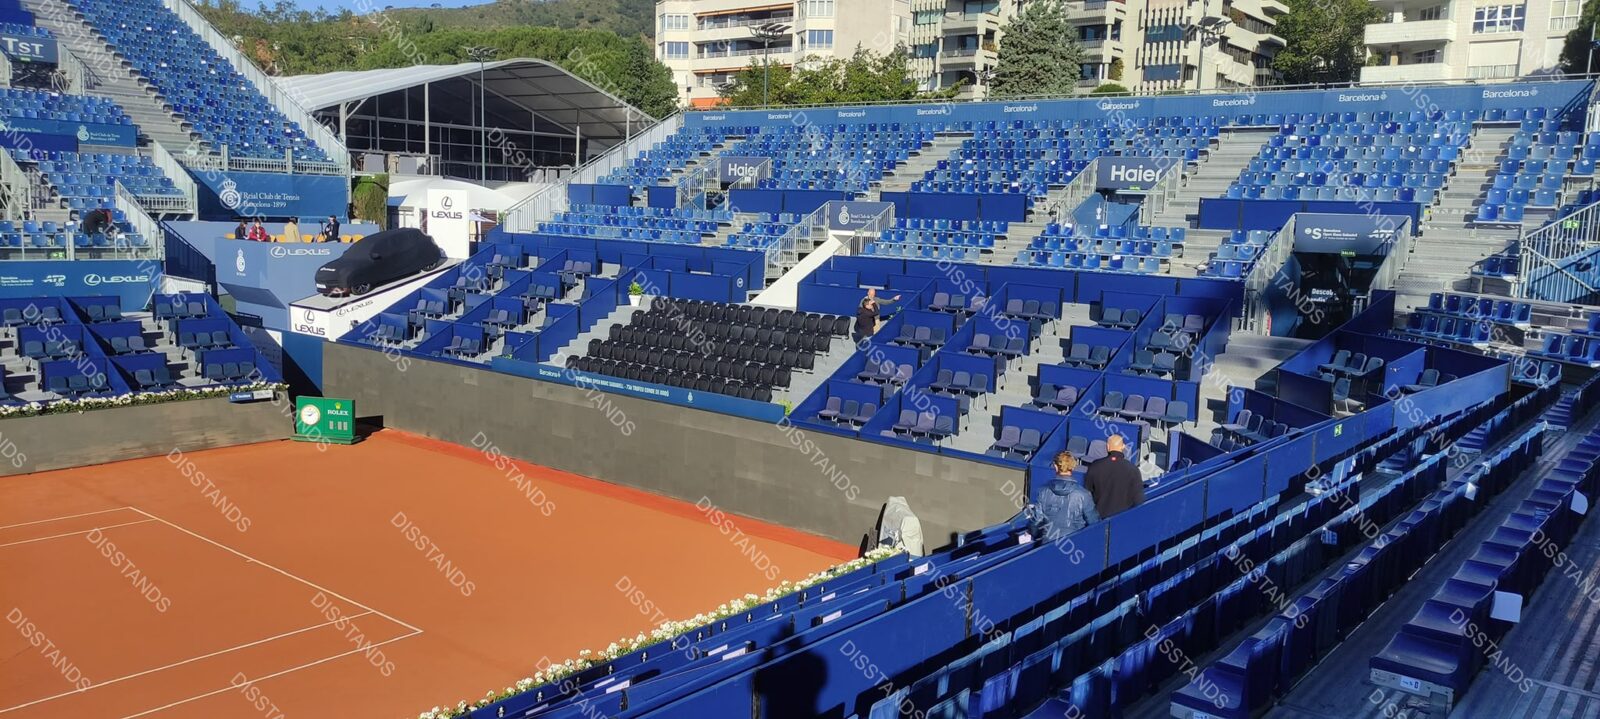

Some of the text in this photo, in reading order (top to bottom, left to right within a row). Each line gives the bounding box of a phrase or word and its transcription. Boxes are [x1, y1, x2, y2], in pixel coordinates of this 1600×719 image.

[2, 37, 44, 54] TST
[1338, 93, 1380, 102] Barcelona
[1482, 90, 1530, 98] Barcelona
[1102, 102, 1134, 110] Barcelona
[728, 163, 758, 176] Haier
[1111, 165, 1162, 182] Haier
[432, 211, 462, 219] LEXUS
[42, 275, 66, 283] ATP
[347, 300, 373, 313] LEXUS
[295, 324, 325, 335] LEXUS
